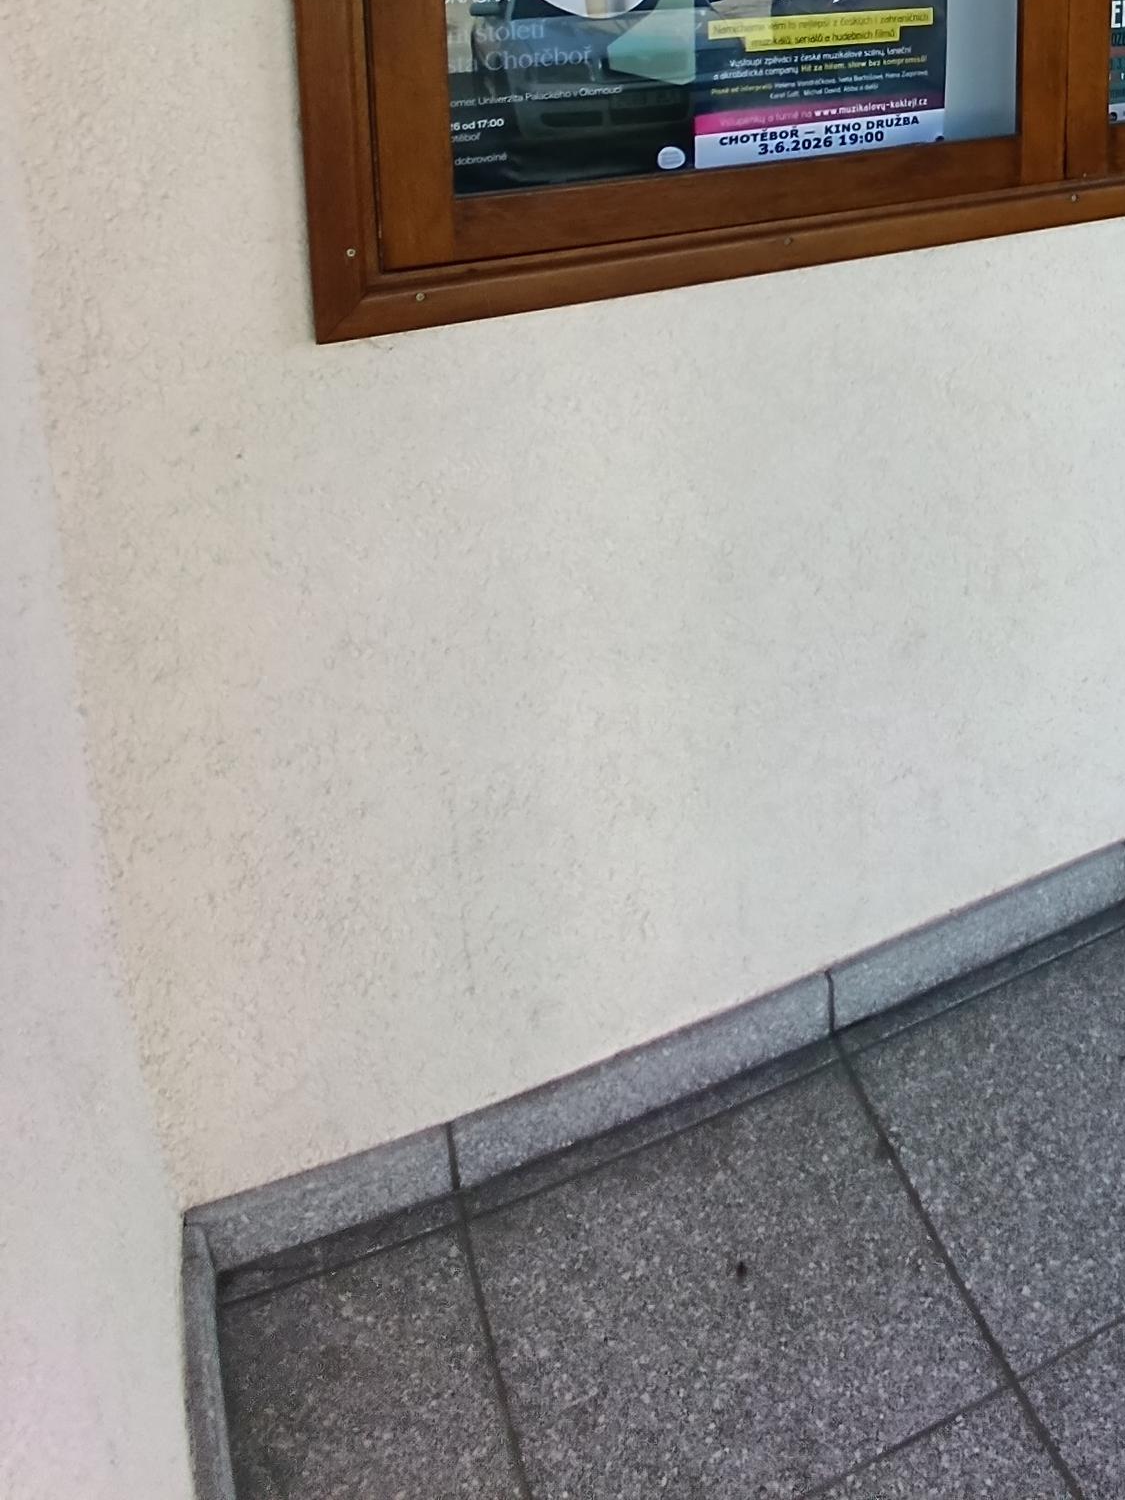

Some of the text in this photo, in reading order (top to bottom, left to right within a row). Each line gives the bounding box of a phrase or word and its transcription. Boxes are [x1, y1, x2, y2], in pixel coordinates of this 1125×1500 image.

[832, 30, 874, 42] hudebních
[485, 46, 593, 72] Chotěboř
[764, 55, 792, 66] zpěváci
[800, 52, 822, 62] české
[822, 50, 863, 60] muzikálové
[847, 61, 867, 69] show
[868, 59, 881, 67] bez
[525, 89, 572, 102] Palackého
[579, 85, 623, 98] Olomouci
[462, 117, 504, 132] od 17:00
[719, 112, 921, 147] CHOTĚBOŘ KINO DRUŽBA
[757, 130, 885, 157] 3.6.2026 19:00
[454, 152, 508, 167] dobrovolné
